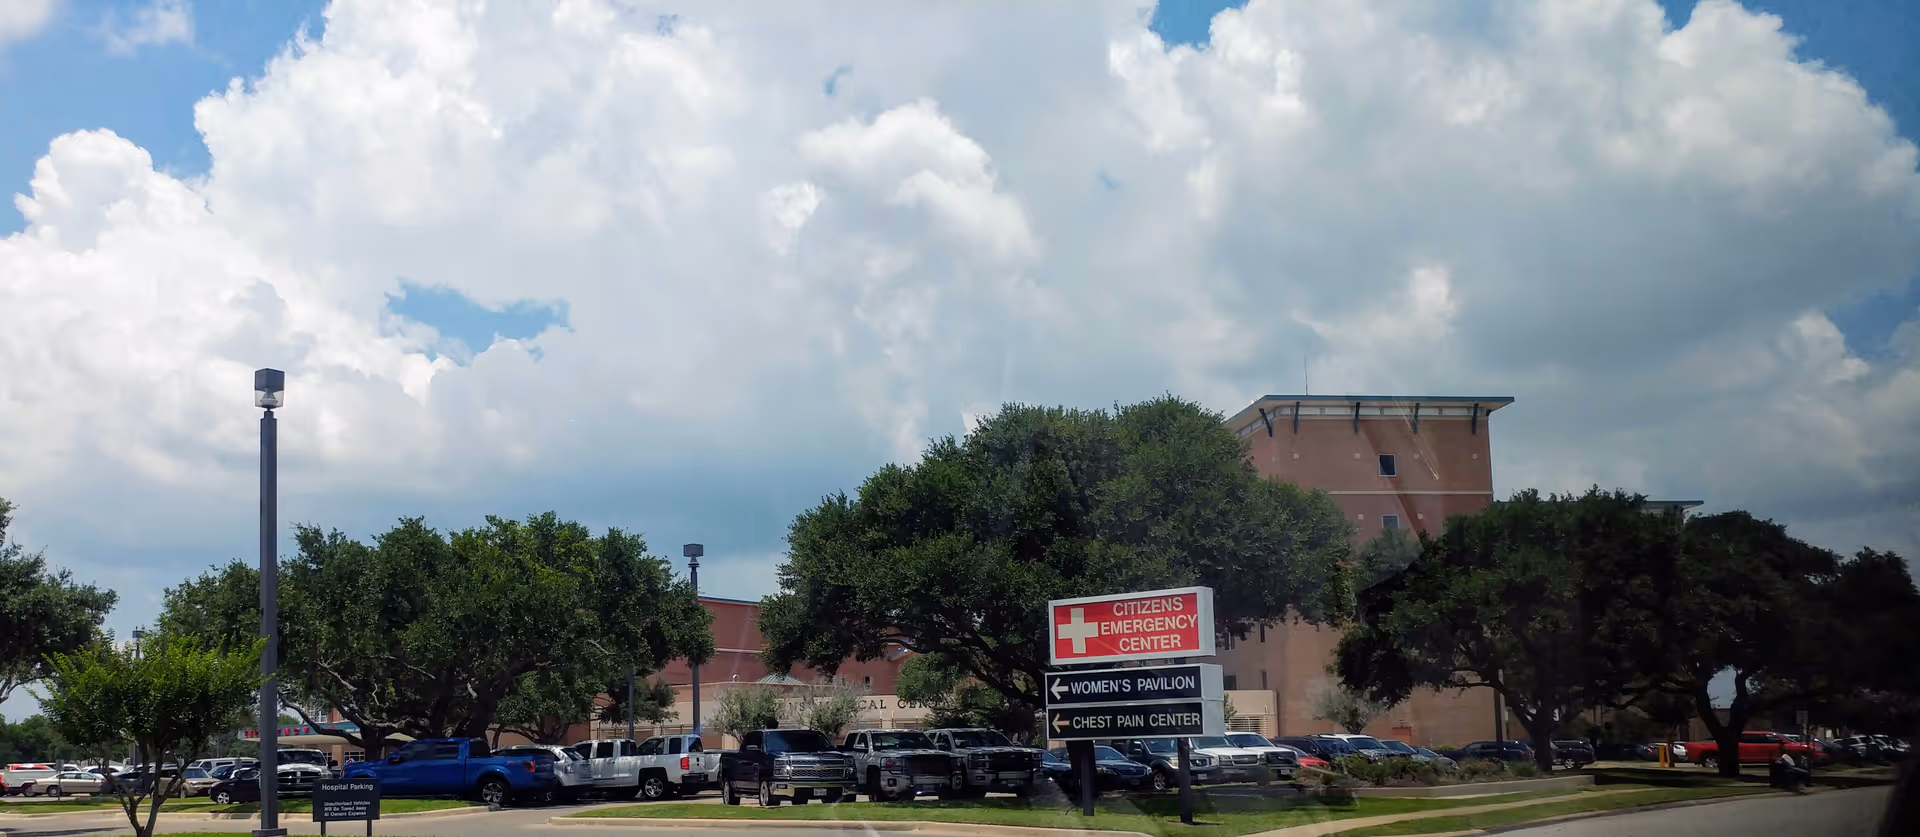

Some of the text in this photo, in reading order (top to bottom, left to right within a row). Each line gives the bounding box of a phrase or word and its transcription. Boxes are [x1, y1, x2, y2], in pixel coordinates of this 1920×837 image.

[1113, 597, 1183, 616] CITIZENS
[1101, 614, 1198, 635] EMERGENCY
[1119, 634, 1181, 651] CENTER
[1071, 676, 1195, 694] WOMEN'S PAVILION
[1072, 712, 1200, 729] CHEST PAIN CENTER
[321, 783, 374, 791] Hospital Parking
